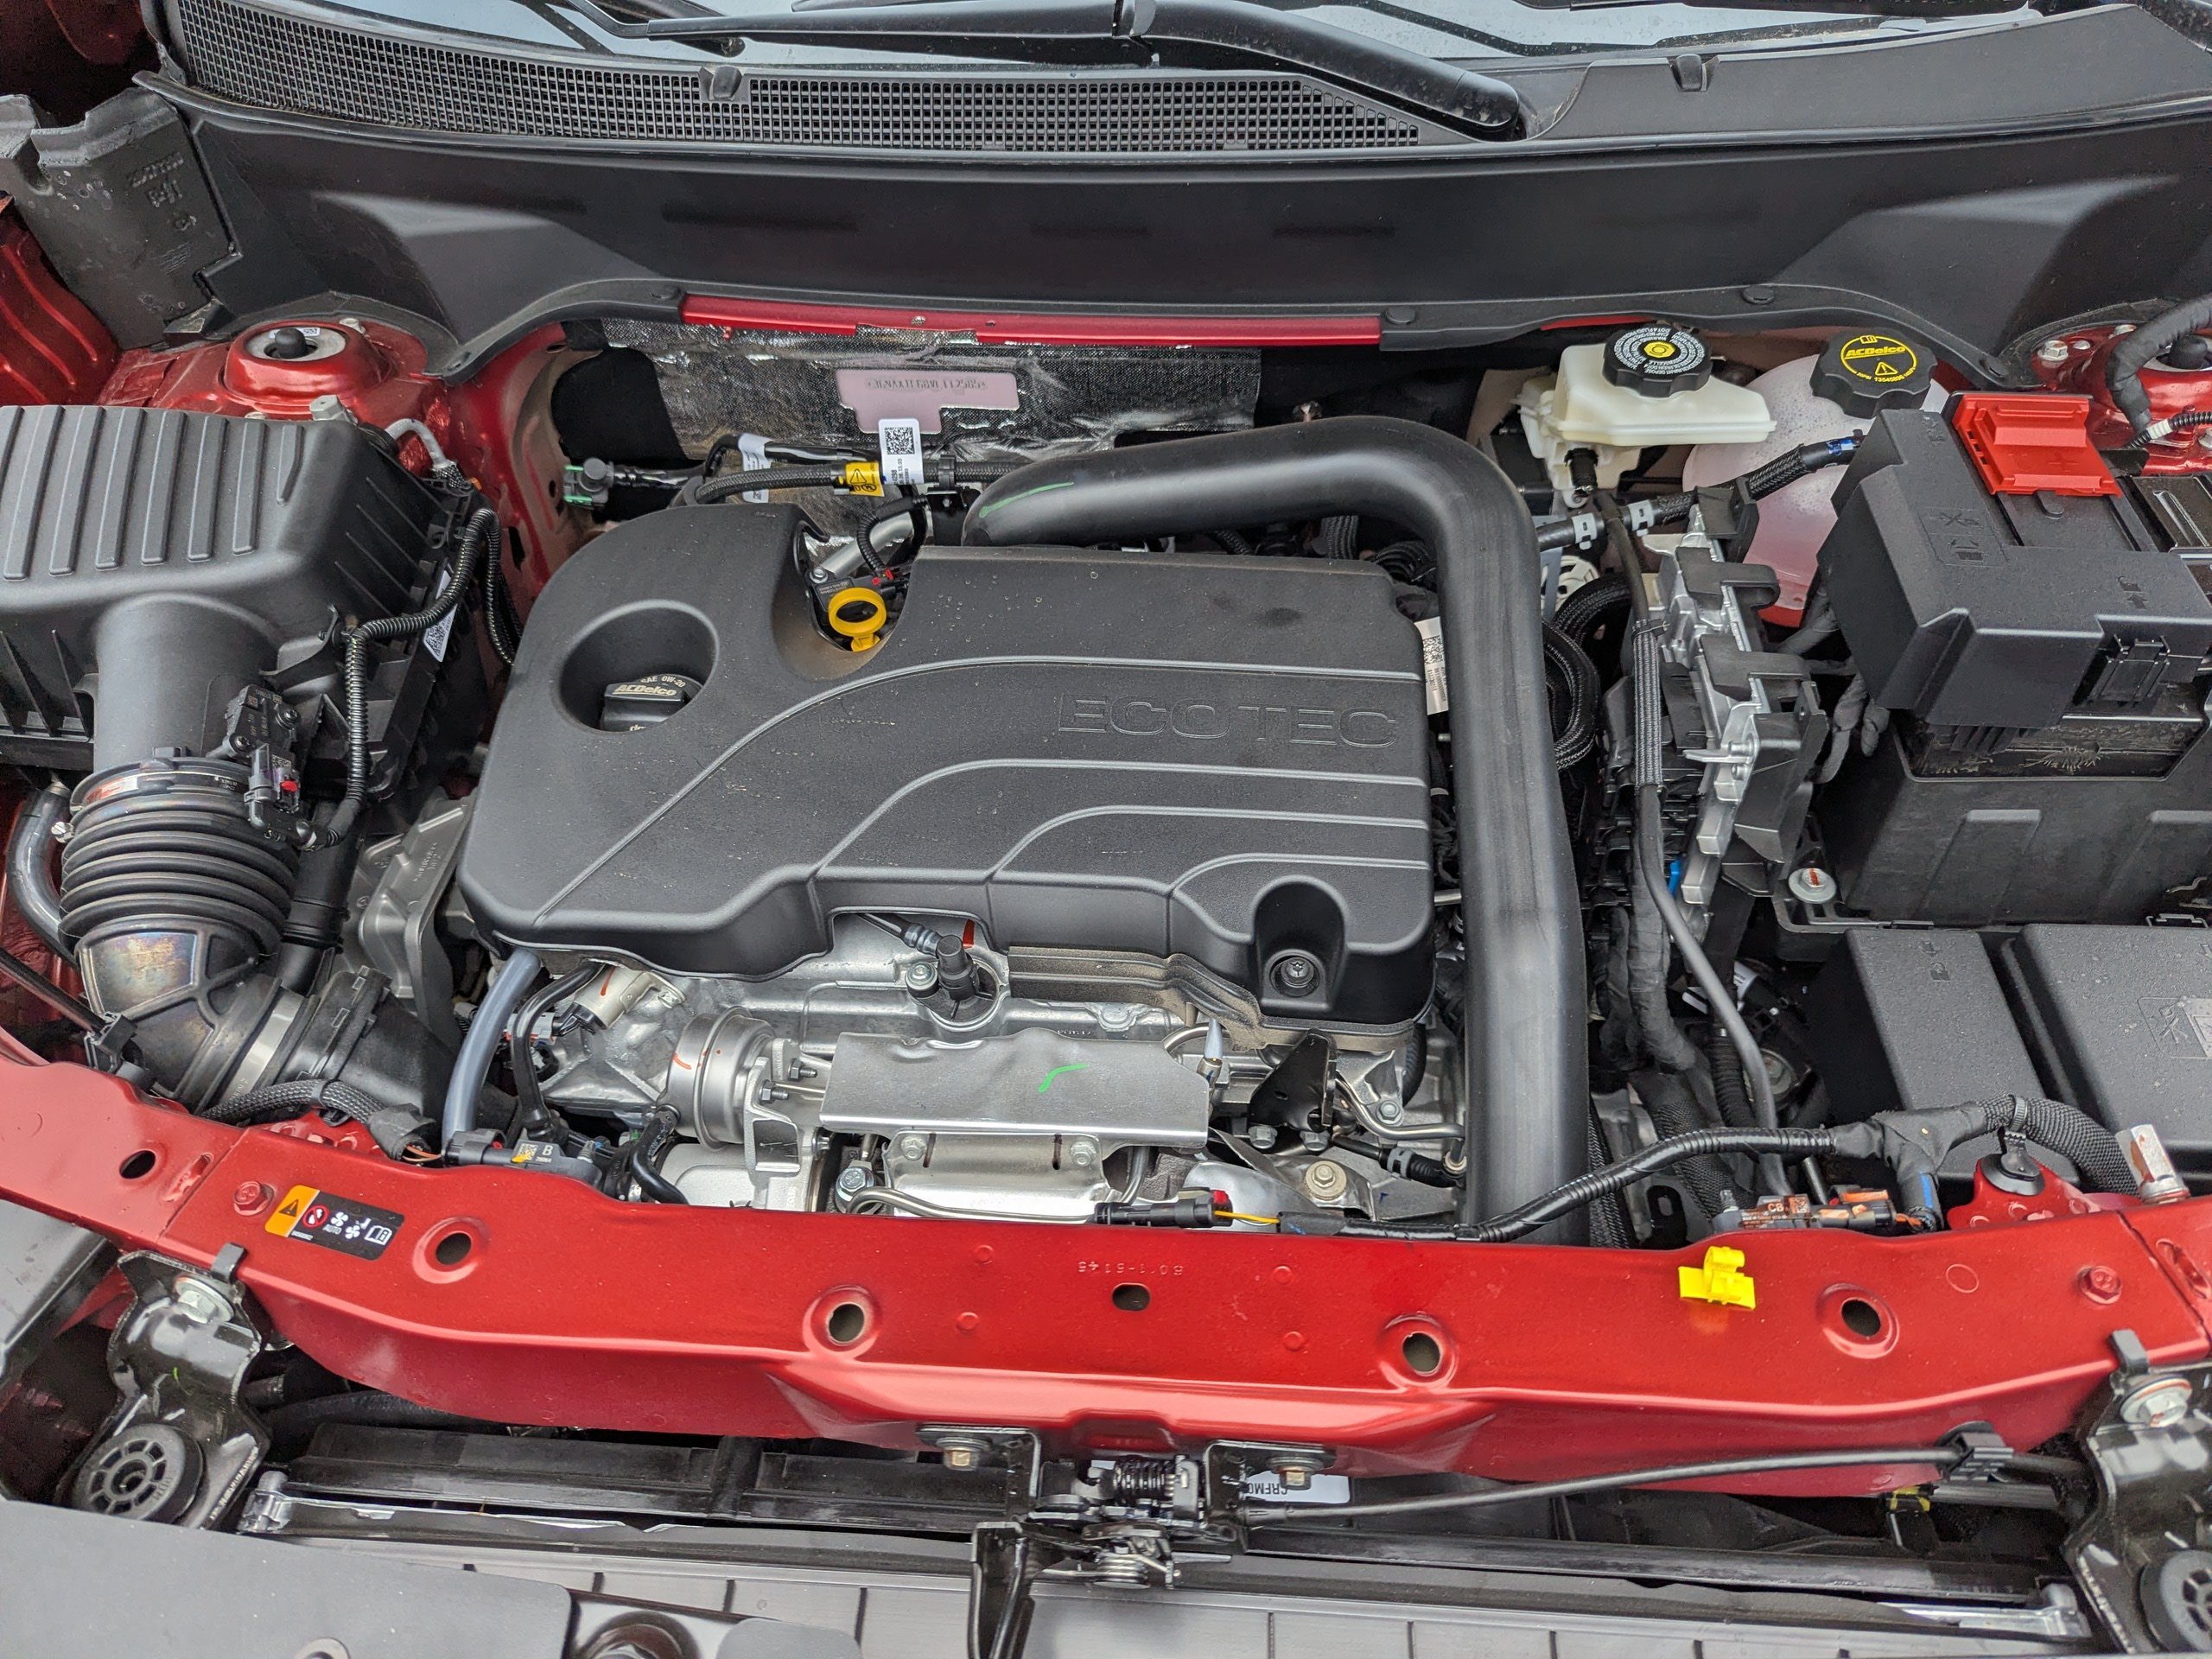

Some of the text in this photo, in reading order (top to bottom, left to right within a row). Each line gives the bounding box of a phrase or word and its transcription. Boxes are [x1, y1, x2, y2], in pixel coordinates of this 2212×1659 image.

[1846, 346, 1906, 357] ACDelco
[661, 676, 686, 688] 0W-20
[613, 684, 677, 696] ACDelco
[1058, 693, 1398, 749] ECOTEC
[322, 1224, 342, 1236] AUTO
